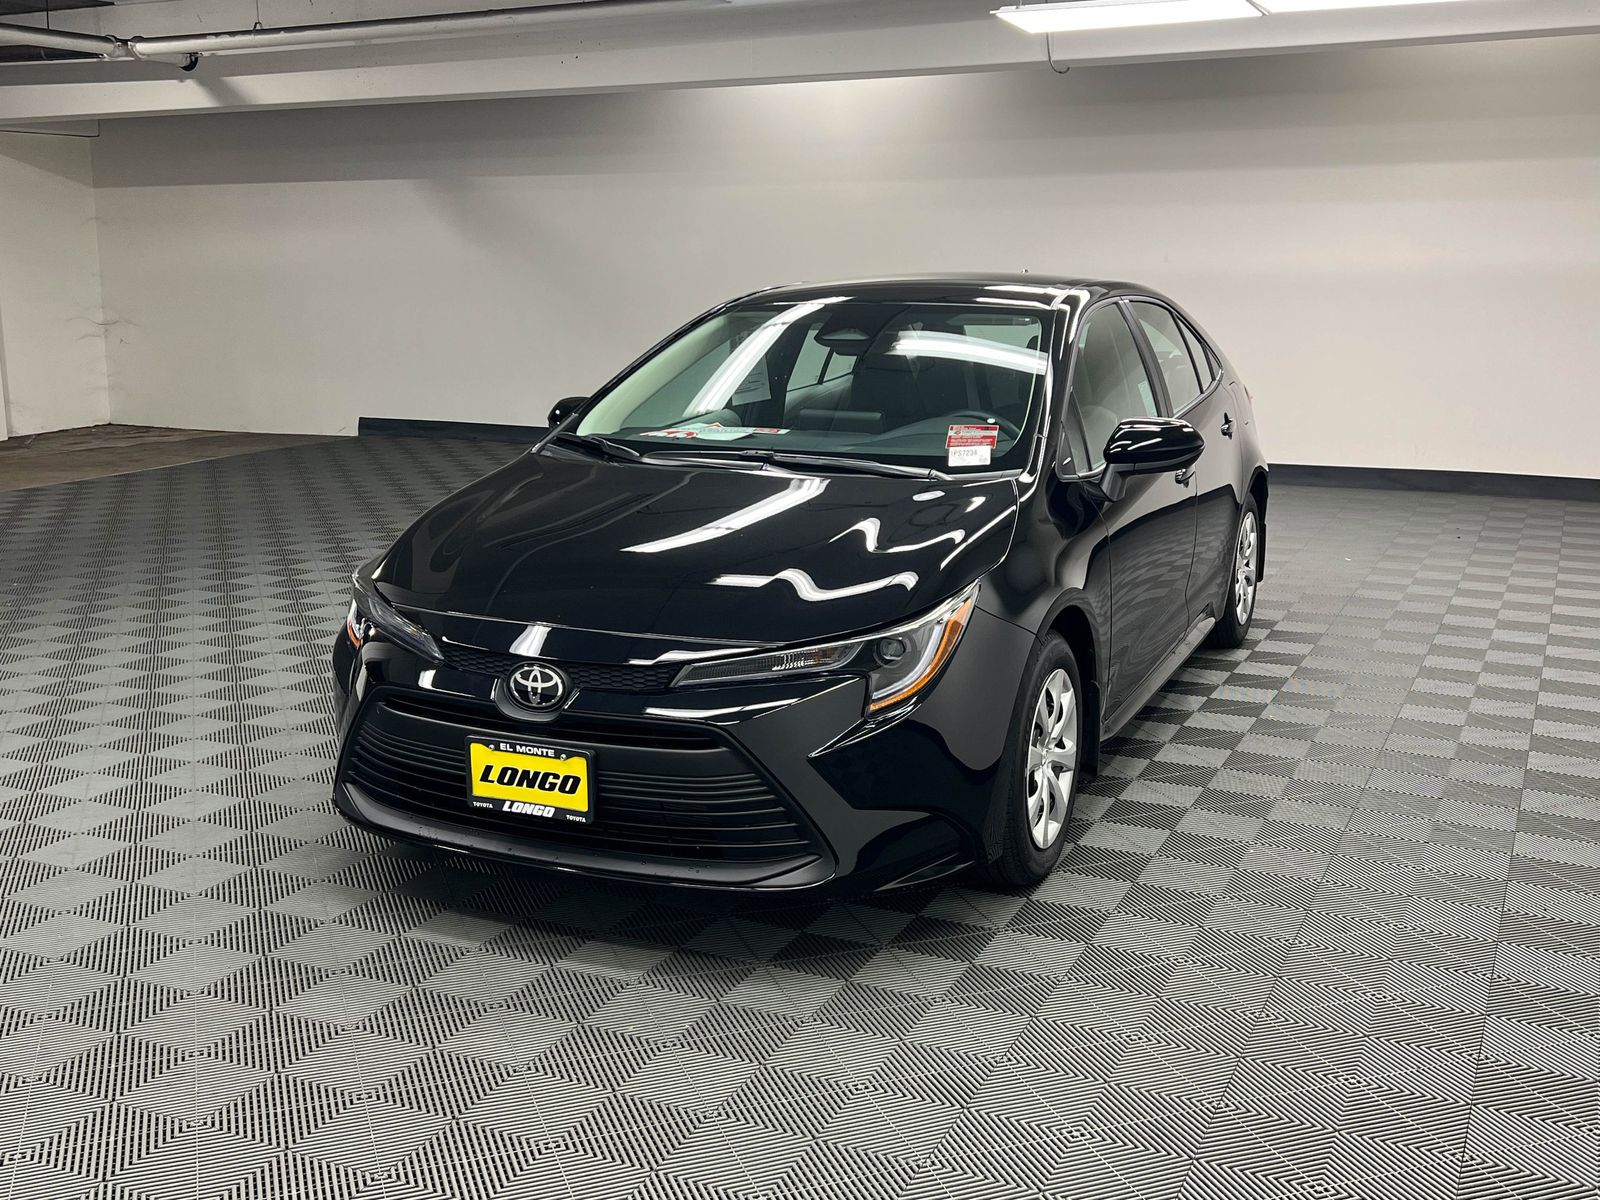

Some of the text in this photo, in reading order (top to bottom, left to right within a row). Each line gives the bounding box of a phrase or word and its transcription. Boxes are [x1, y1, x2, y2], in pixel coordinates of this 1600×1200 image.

[500, 743, 555, 757] EL MONTE
[479, 764, 581, 794] LONGO
[472, 800, 586, 823] TOYOTA LONGO TOYOTA
